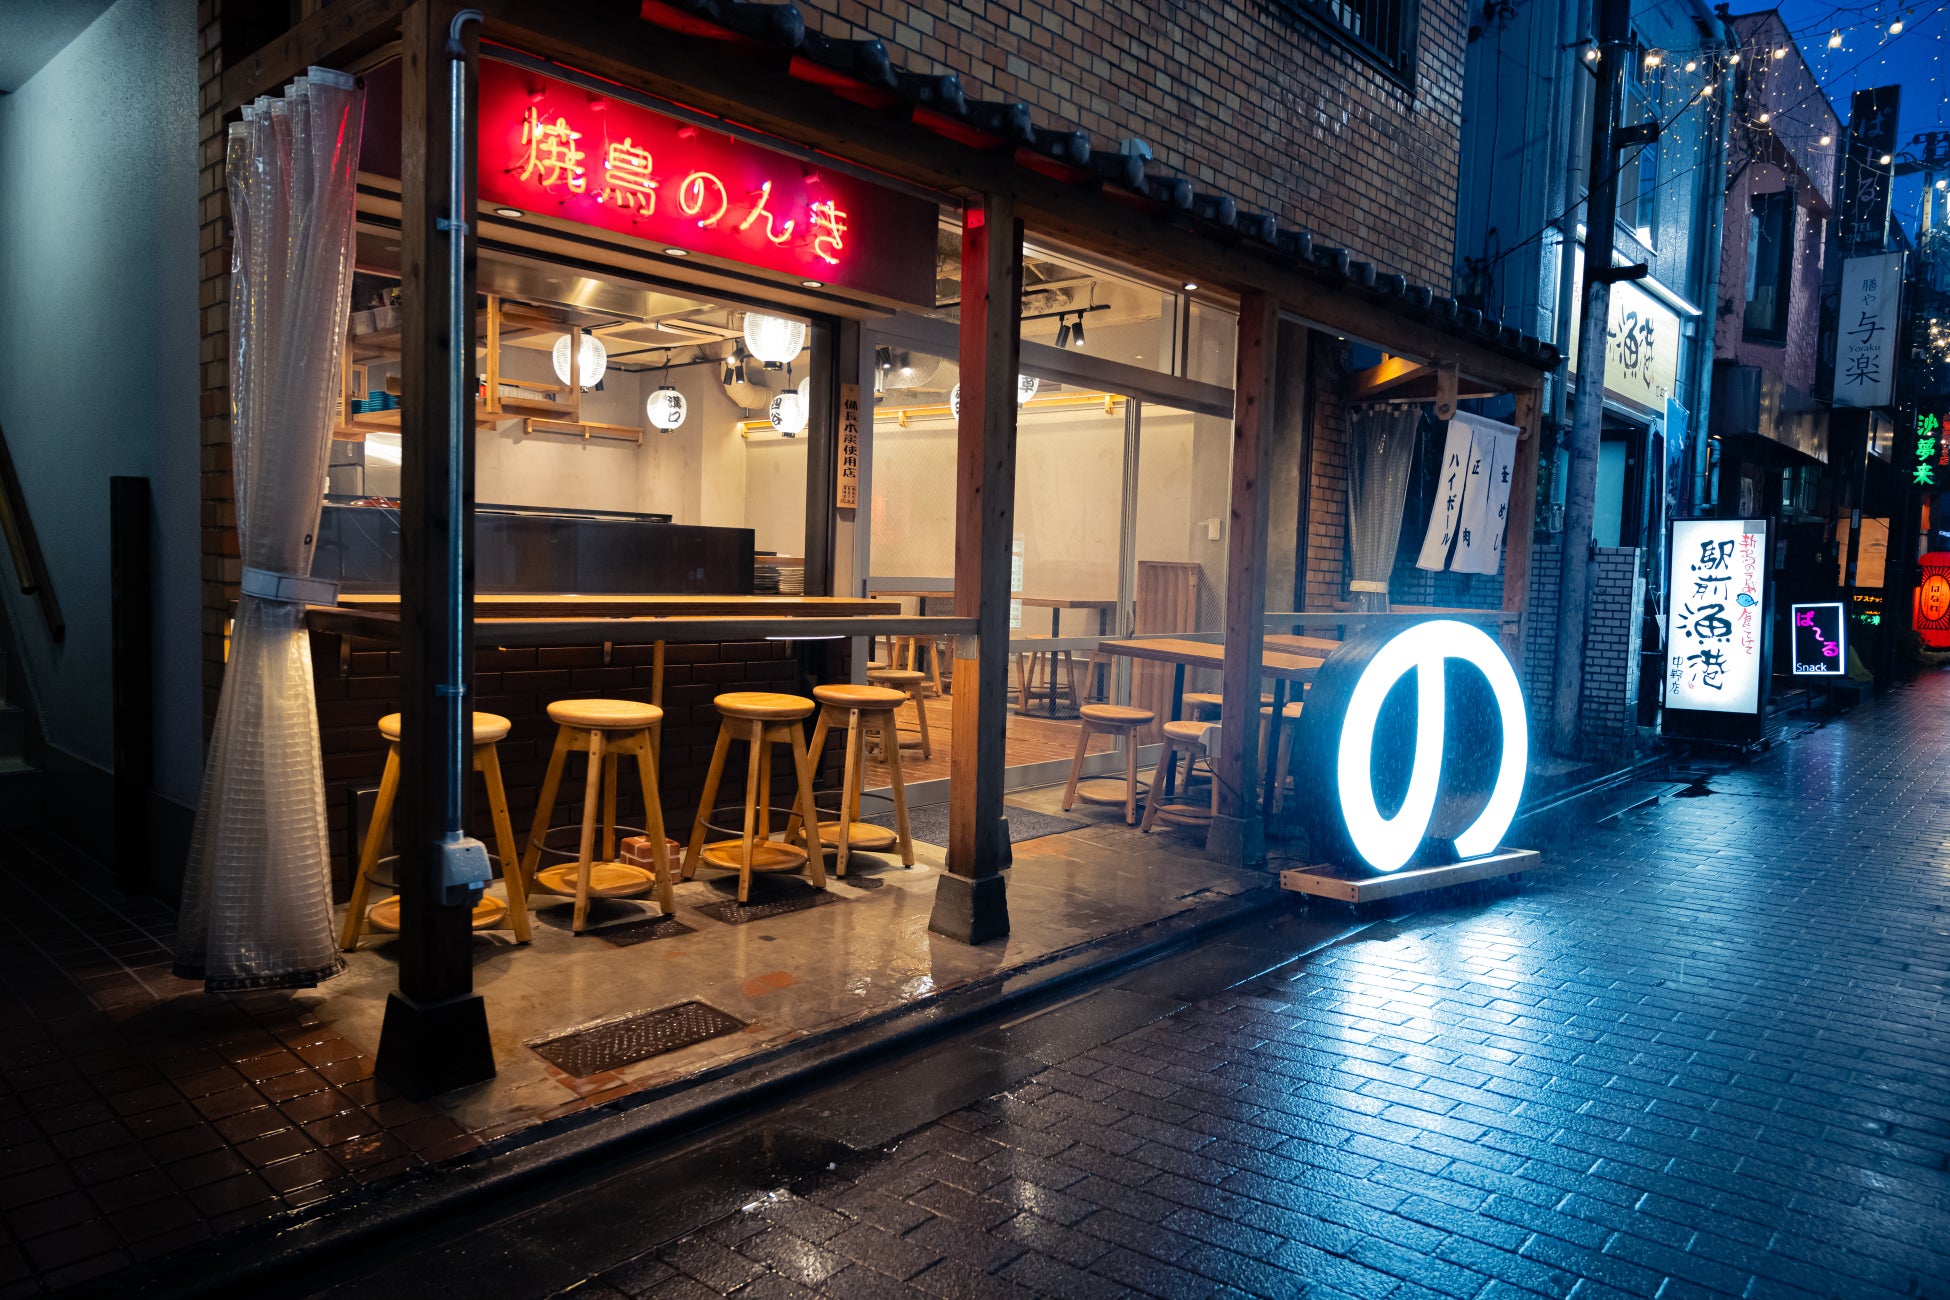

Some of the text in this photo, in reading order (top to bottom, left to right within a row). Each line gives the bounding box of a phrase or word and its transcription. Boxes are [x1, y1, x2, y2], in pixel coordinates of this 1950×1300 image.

[519, 106, 848, 265] 焼鳥のんき
[1851, 222, 1871, 231] TEL
[1849, 343, 1881, 354] Yoraku
[1913, 413, 1939, 486] 沙夢来
[1441, 453, 1460, 547] ハイボール
[1462, 459, 1482, 549] 正肉
[1493, 465, 1510, 552] 釜めし
[1675, 539, 1735, 691] 駅前漁港
[1930, 585, 1940, 612] はなれ
[1796, 662, 1827, 672] Snack
[1338, 620, 1528, 872] の
